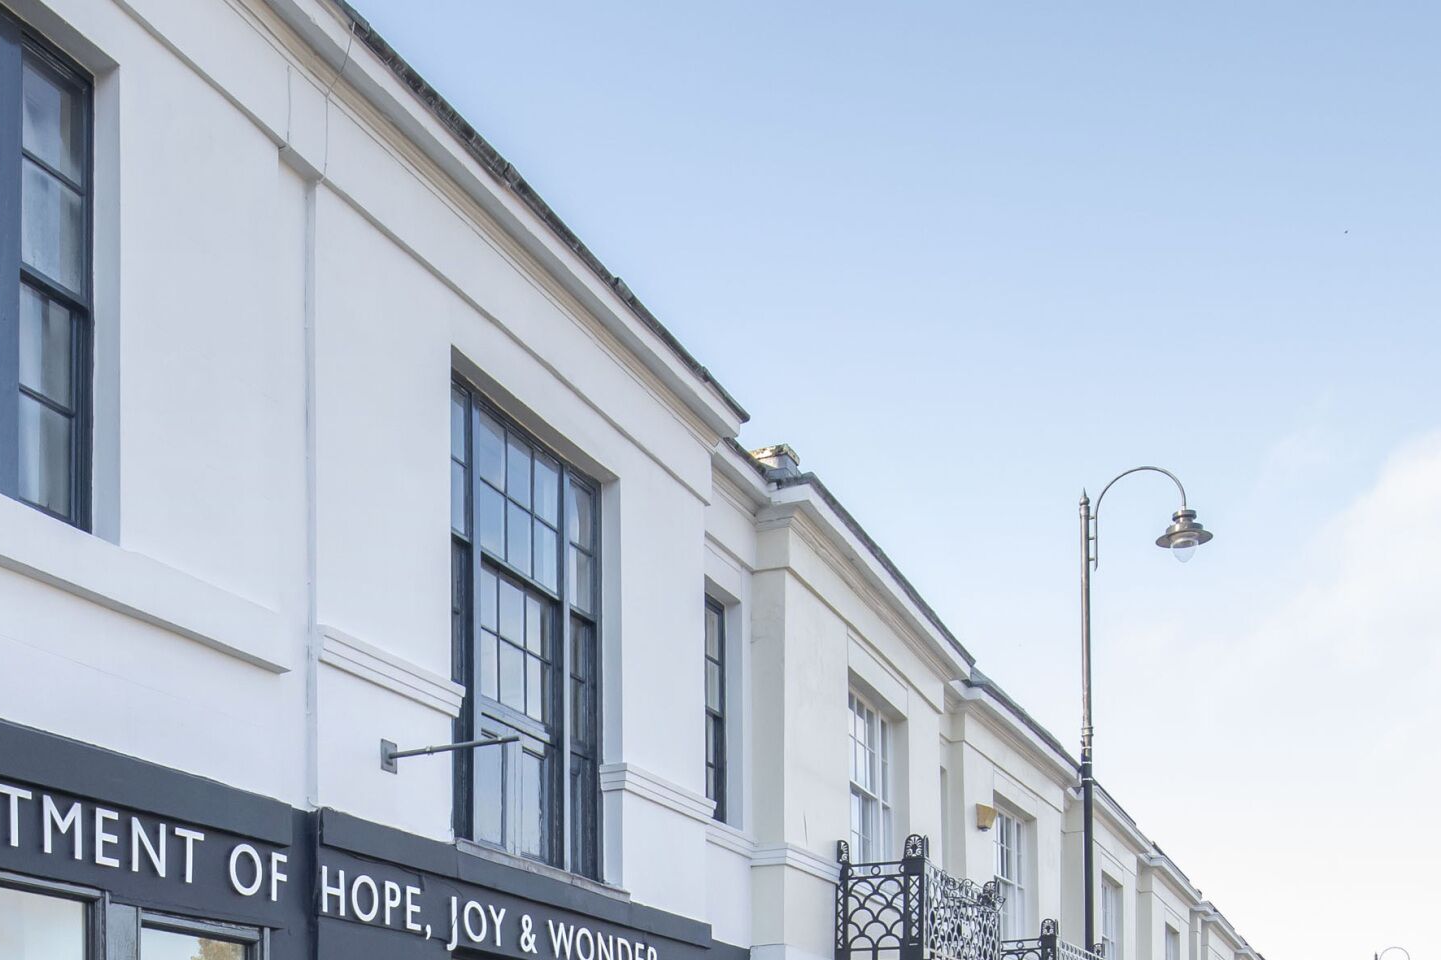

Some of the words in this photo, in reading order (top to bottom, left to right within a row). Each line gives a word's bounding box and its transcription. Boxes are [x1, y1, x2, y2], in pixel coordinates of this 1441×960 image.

[228, 842, 288, 902] OF
[320, 864, 432, 941] HOPE,
[446, 895, 507, 952] JOY
[519, 915, 537, 955] &
